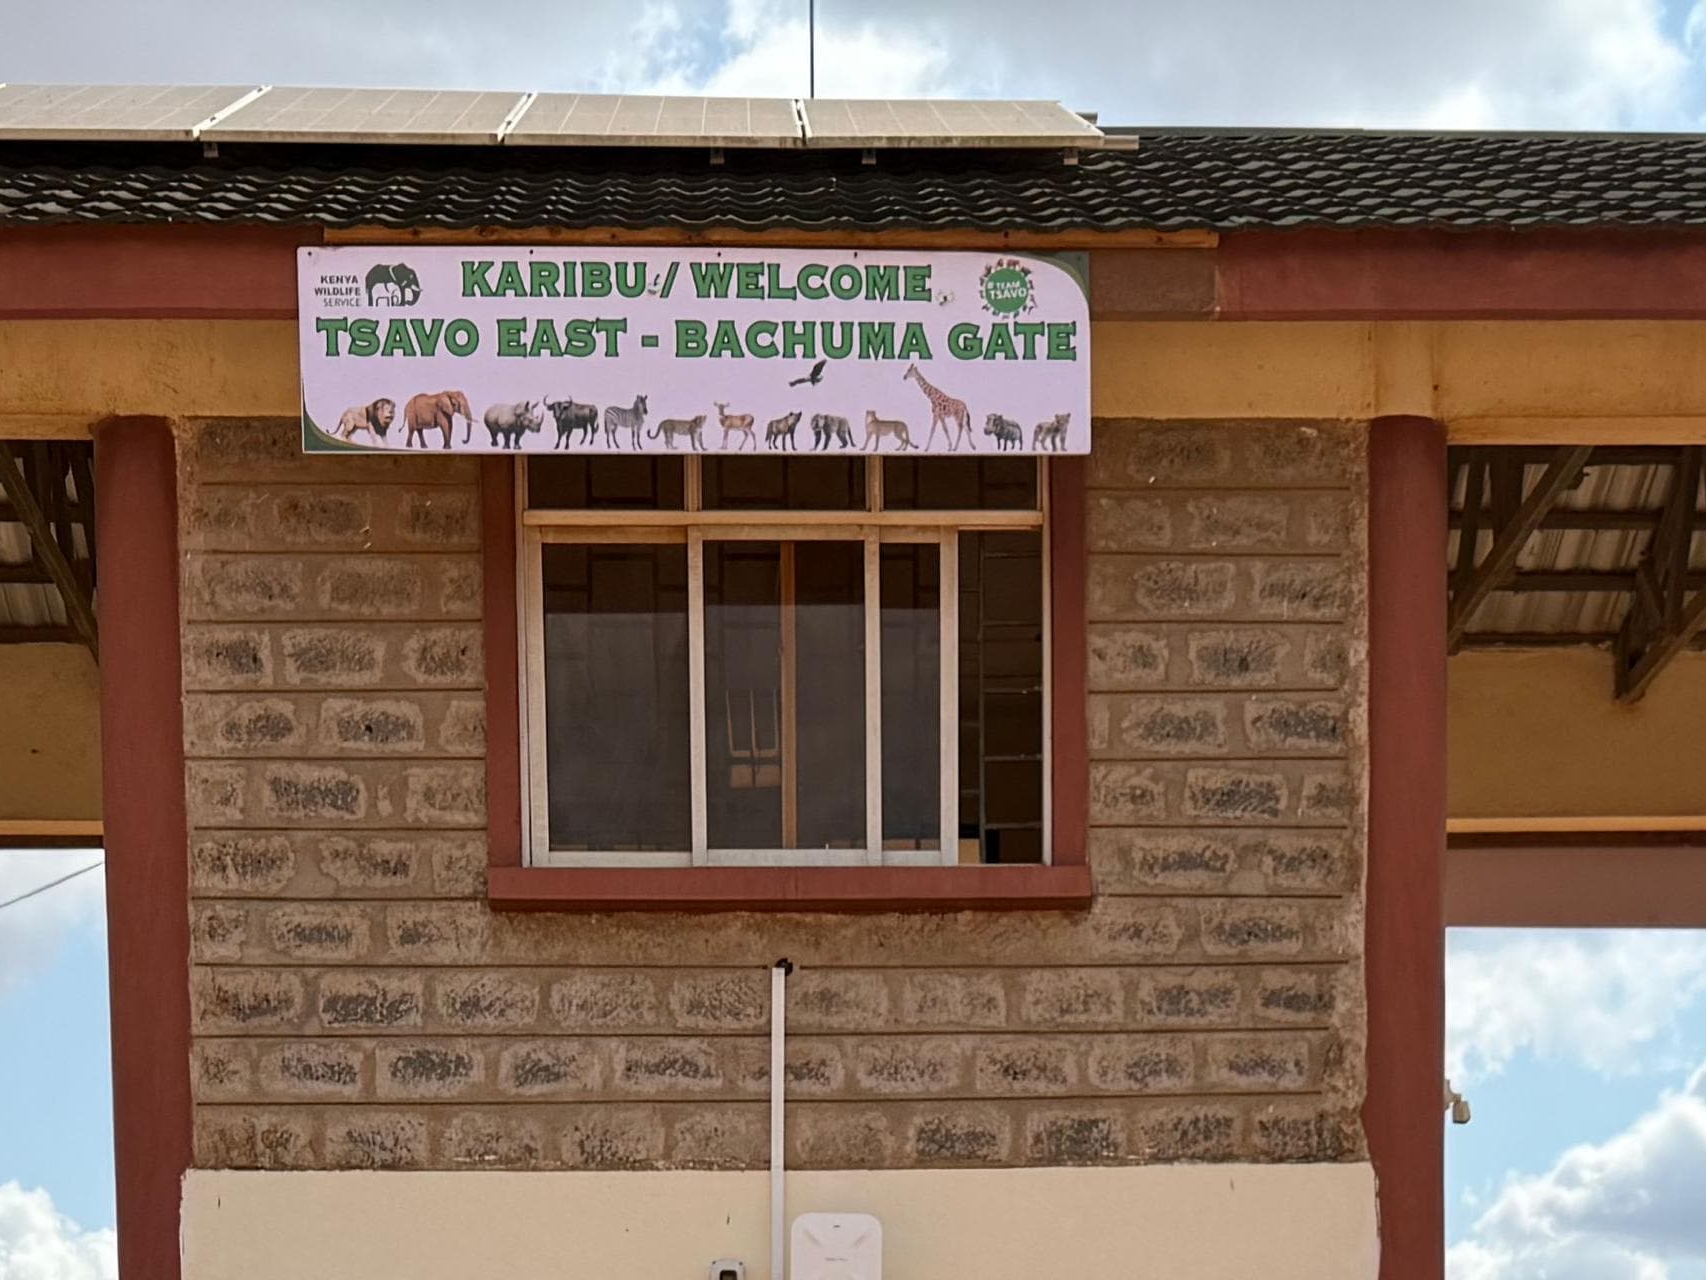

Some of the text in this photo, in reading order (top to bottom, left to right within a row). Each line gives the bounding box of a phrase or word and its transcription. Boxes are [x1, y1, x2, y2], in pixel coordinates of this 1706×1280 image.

[320, 275, 358, 284] KENYA
[461, 261, 647, 298] KARIBU
[689, 261, 933, 302] WELCOME
[314, 287, 361, 296] WILDLIFE
[989, 288, 1027, 299] TSAVO
[323, 298, 361, 307] SERVICE
[316, 317, 480, 357] TSAVO
[496, 317, 628, 358] EAST
[675, 319, 933, 360] BACHUMA
[948, 321, 1077, 361] GATE
